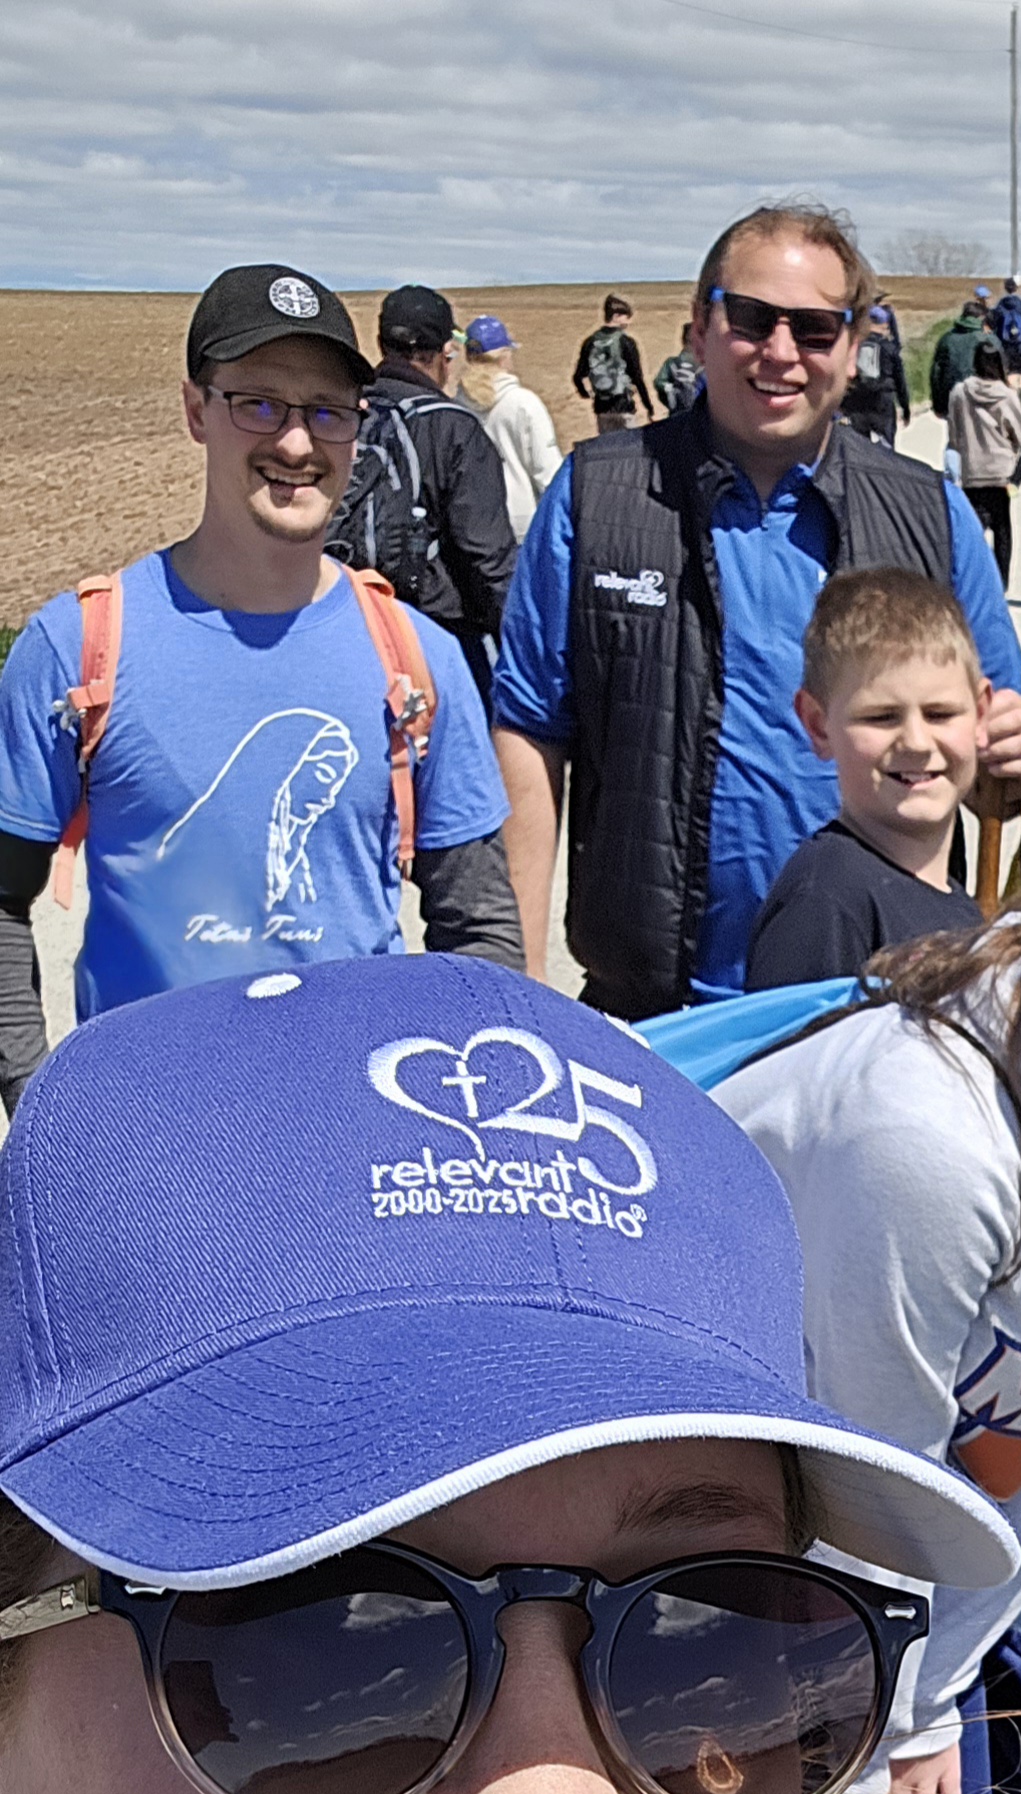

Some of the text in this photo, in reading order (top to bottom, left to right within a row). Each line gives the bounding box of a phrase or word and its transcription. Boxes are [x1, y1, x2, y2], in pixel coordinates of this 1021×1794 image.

[463, 1025, 659, 1195] 25
[370, 1146, 576, 1193] relevant
[371, 1187, 515, 1218] 2000-2025
